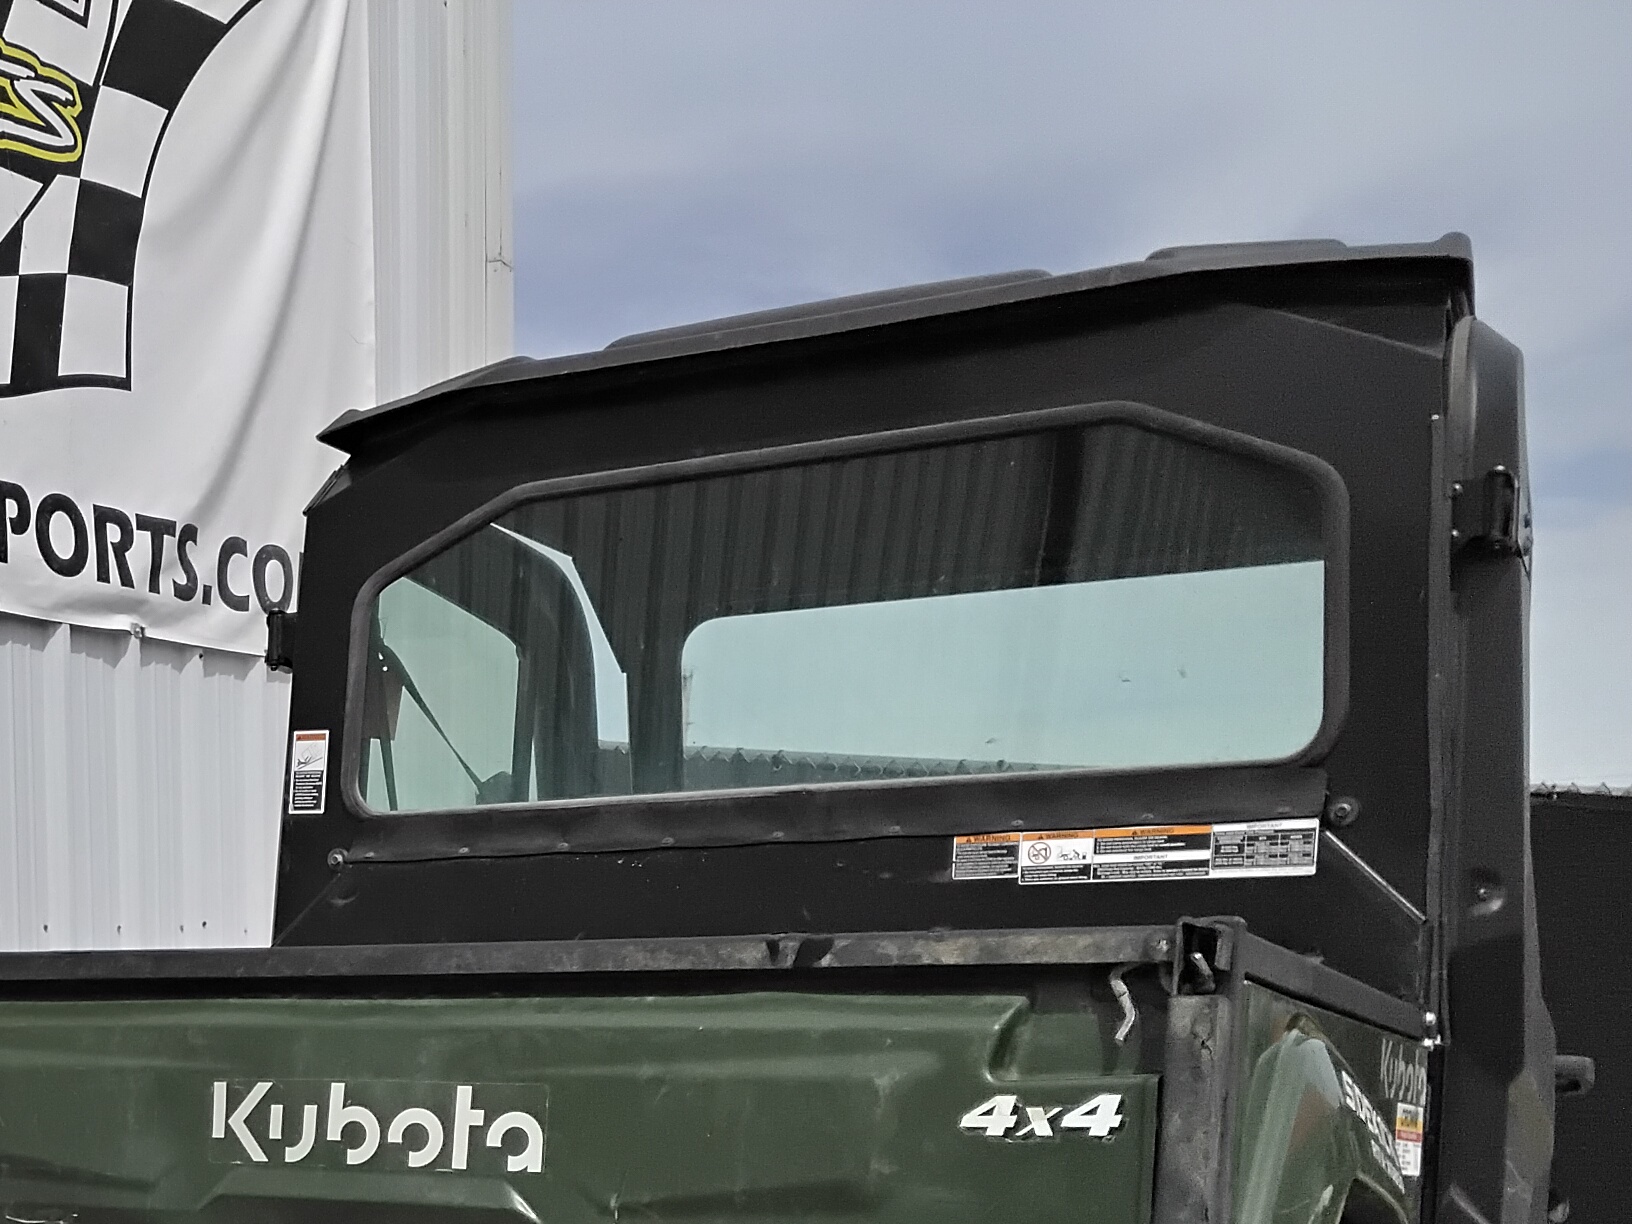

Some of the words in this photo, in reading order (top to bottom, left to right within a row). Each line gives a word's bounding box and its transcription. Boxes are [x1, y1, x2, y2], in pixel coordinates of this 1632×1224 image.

[1380, 1038, 1426, 1107] Kubota
[211, 1081, 544, 1173] Kubota
[958, 1092, 1123, 1137] 4x4
